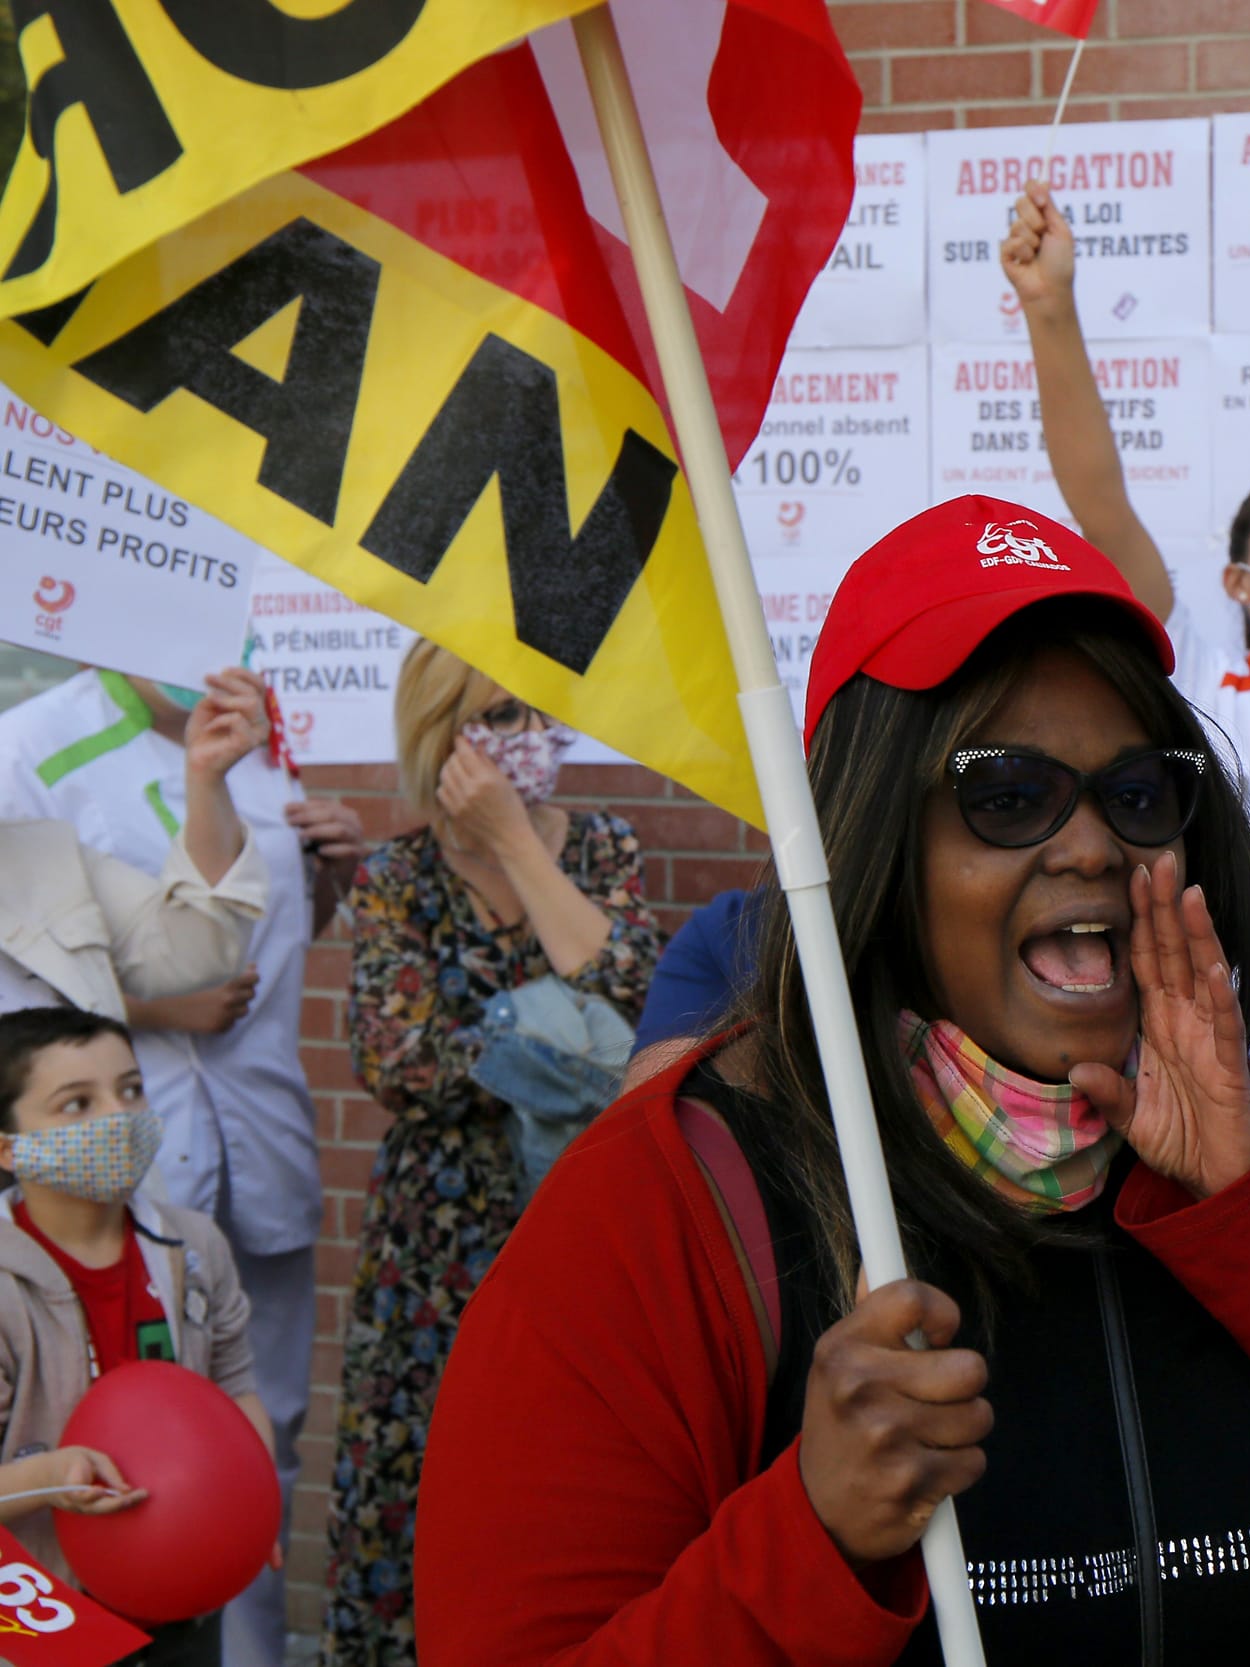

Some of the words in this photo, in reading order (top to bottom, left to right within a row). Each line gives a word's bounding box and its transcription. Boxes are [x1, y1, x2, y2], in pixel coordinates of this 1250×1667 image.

[956, 150, 1175, 196] ABROGATION
[1084, 202, 1123, 225] LOI
[824, 243, 883, 270] AIL
[944, 240, 990, 264] SUR
[954, 357, 1181, 393] AUGMATION
[978, 400, 1022, 421] DES
[831, 414, 911, 437] absent
[10, 214, 680, 677] AN
[970, 431, 1030, 452] DANS
[751, 449, 862, 487] 100%
[0, 449, 95, 499] LENT
[102, 479, 190, 528] PLUS
[97, 527, 239, 589] PROFITS
[272, 624, 401, 652] PÉNIBILITÉ
